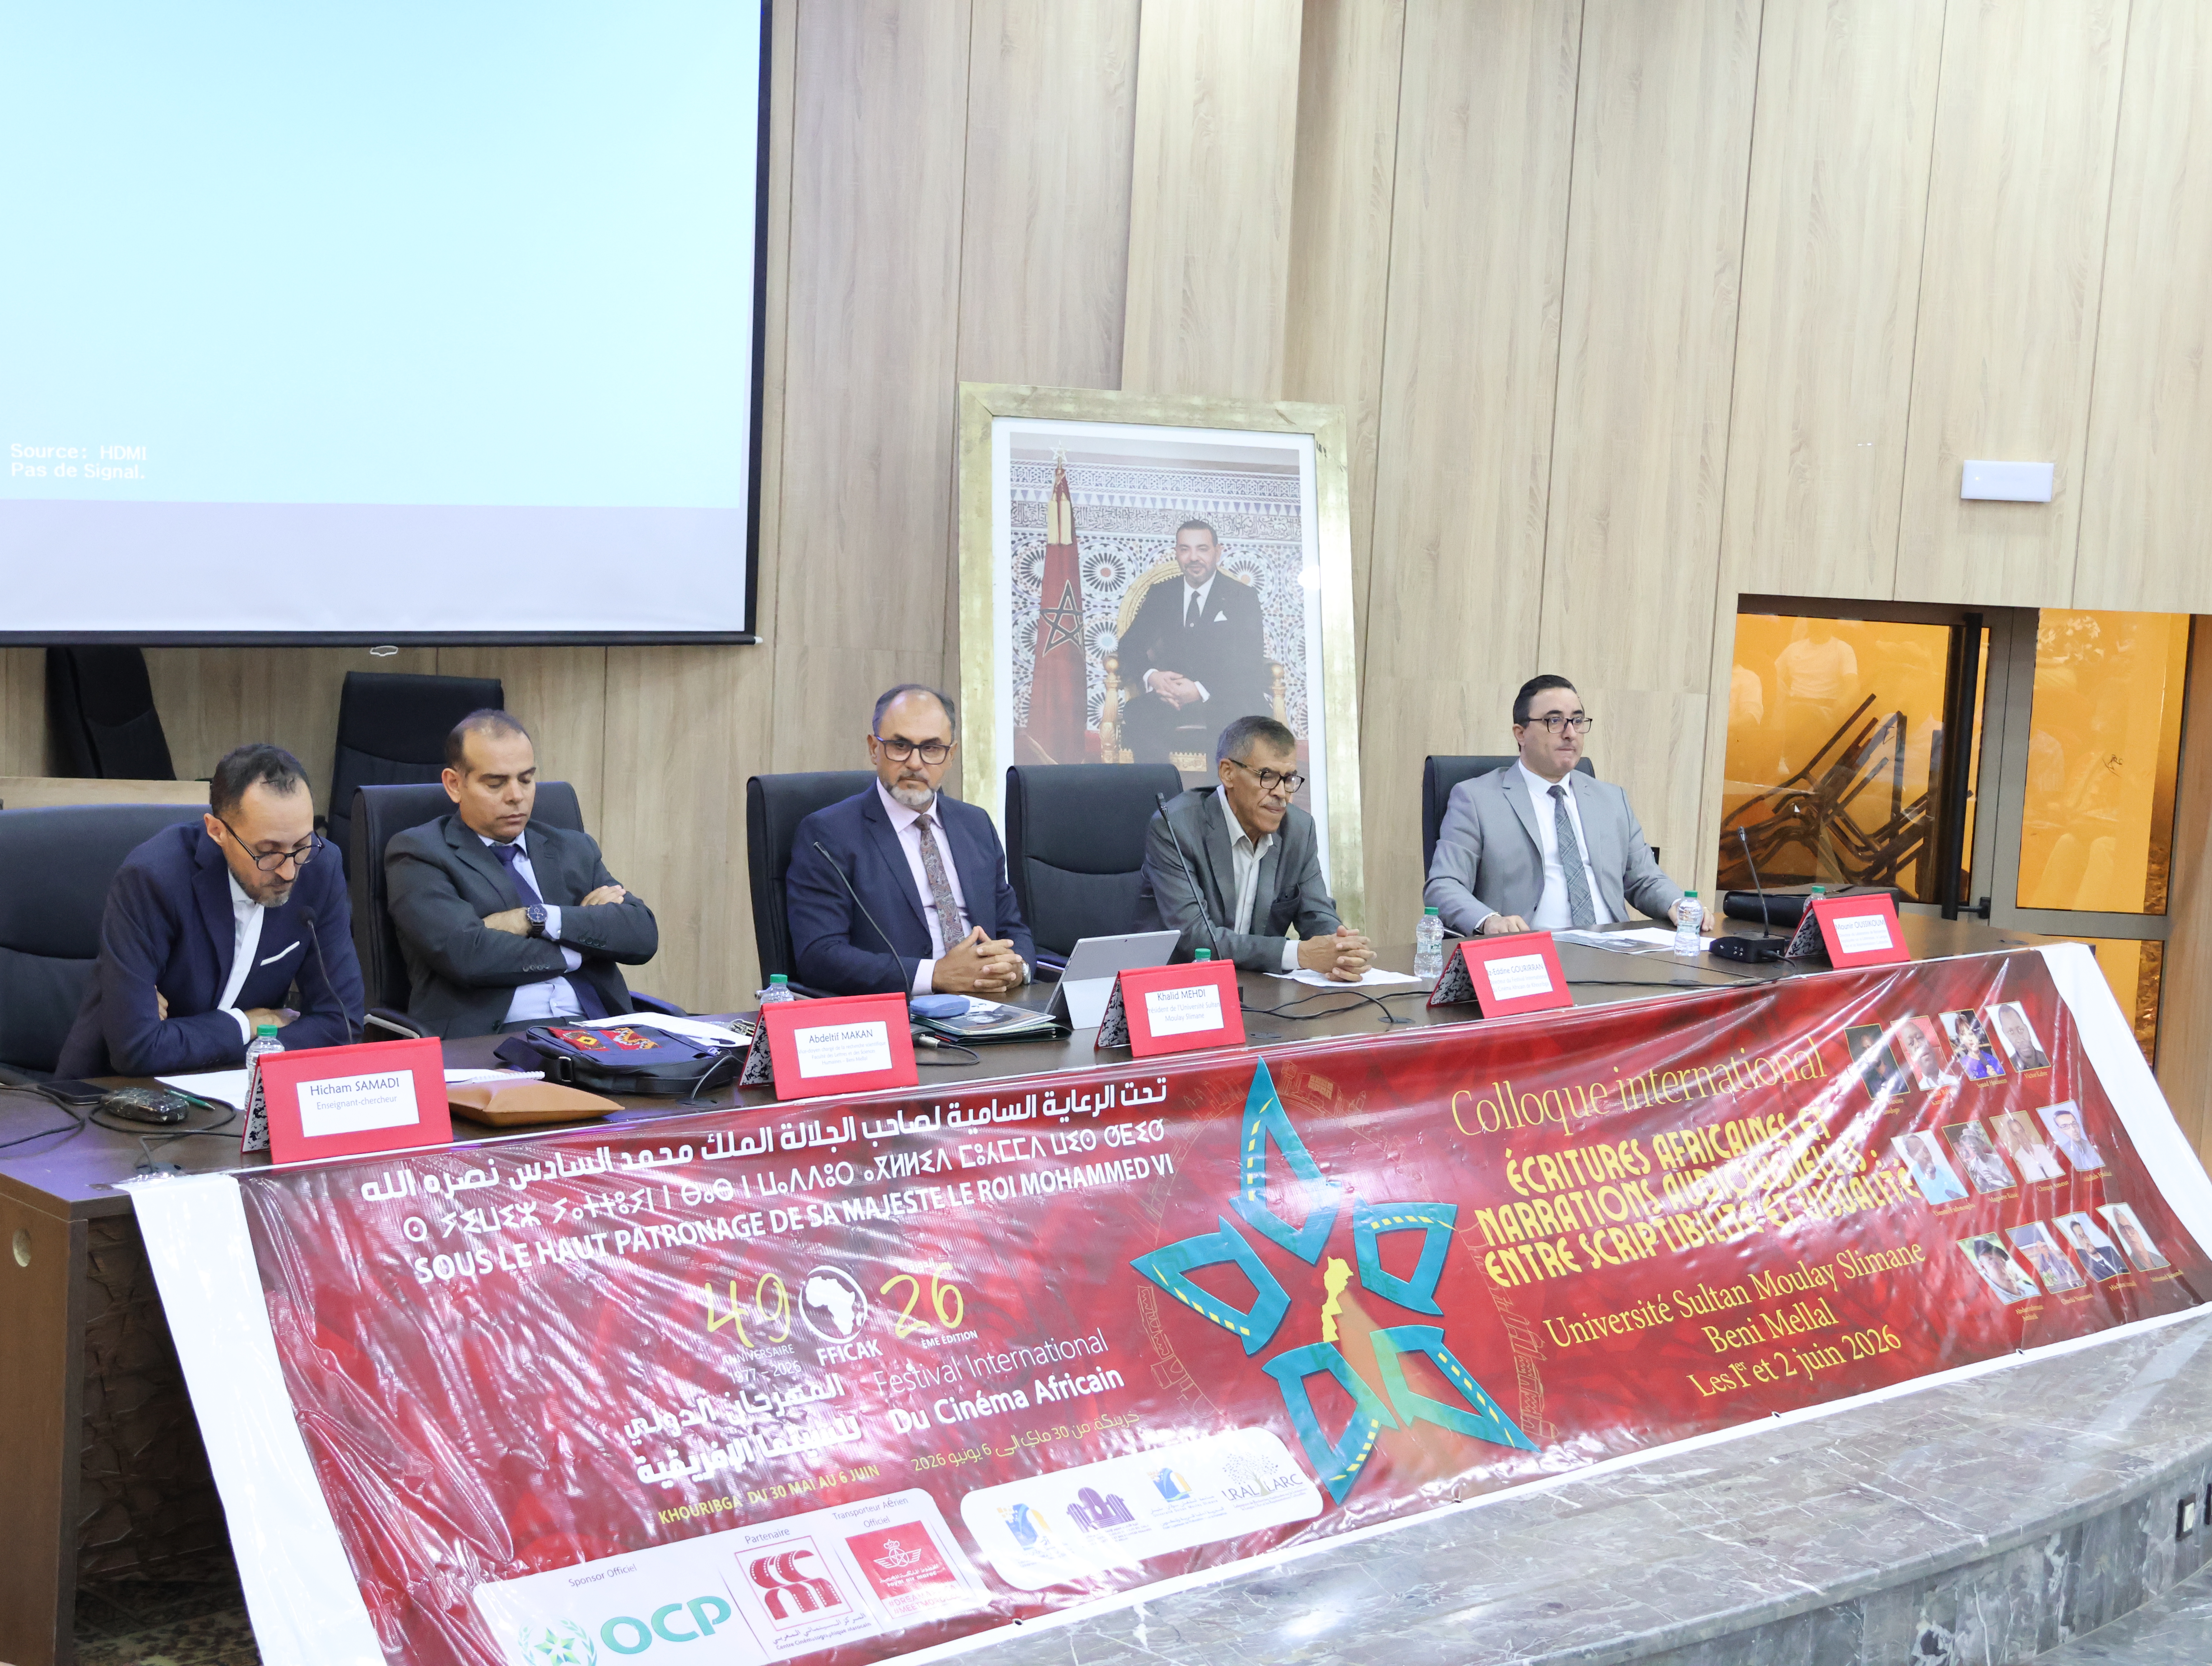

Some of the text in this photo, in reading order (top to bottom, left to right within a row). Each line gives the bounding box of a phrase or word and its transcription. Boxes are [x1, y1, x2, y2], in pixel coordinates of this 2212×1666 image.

[100, 445, 147, 460] HDMI
[11, 462, 144, 480] Pas de Signal.
[1854, 919, 1885, 928] OUSSIKOUM
[1511, 963, 1543, 973] GOURIRRAN
[1157, 989, 1206, 1001] Khalid MEHDI
[809, 1029, 873, 1043] Abdeltif MAKAN
[310, 1078, 399, 1096] Hicham SAMADI
[1451, 1036, 1827, 1136] Colloque international
[317, 1095, 397, 1110] Enseignant-chercheur
[361, 1077, 1167, 1202] تحت الرعاية السامية لصاحب الجلالة الملك محمد السادس نصره الله
[1505, 1106, 1831, 1196] ÉCRITURES AFRICAINES ET
[414, 1153, 1174, 1284] SOUS LE HAUT PATRONAGE DE SA MAJESTE LE ROI MOHAMMED VI
[1474, 1178, 1662, 1247] NARRATIONS
[1485, 1236, 1582, 1288] ENTRE
[1762, 1192, 1795, 1228] ET
[880, 1262, 964, 1339] 26
[1542, 1241, 1926, 1348] Université Sultan Moulay Slimane
[705, 1272, 791, 1348] 49
[1701, 1297, 1840, 1353] Beni Mellal
[921, 1330, 978, 1349] ÈME ÉDITION
[722, 1344, 795, 1365] ANNIVERSAIRE
[816, 1339, 883, 1367] FFICAK
[873, 1327, 1110, 1397] Festival International
[1753, 1358, 1780, 1382] et
[1774, 1352, 1798, 1377] 2
[1792, 1342, 1847, 1381] juin
[1841, 1324, 1902, 1360] 2026
[728, 1360, 802, 1384] 1977 2026
[624, 1373, 845, 1446] المهرجان الدولي
[888, 1365, 1125, 1434] Du Cinéma Africain
[756, 1415, 861, 1458] للسينما
[1021, 1429, 1052, 1448] ماي
[1054, 1426, 1070, 1441] 30
[1070, 1423, 1091, 1439] من
[948, 1447, 984, 1467] يونيو
[982, 1443, 992, 1456] 6
[911, 1454, 947, 1471] 2026
[658, 1464, 880, 1525] KHOURIBGA DU 30 MAI AU 6 JUIN
[1222, 1484, 1260, 1501] LRAL
[1263, 1474, 1303, 1492] LARC
[832, 1496, 909, 1521] Transporteur Aérien
[864, 1516, 891, 1528] Officiel
[745, 1527, 790, 1545] Partenaire
[568, 1563, 637, 1587] Sponsor Officiel
[917, 1570, 938, 1579] maroc
[600, 1596, 731, 1655] OCP
[847, 1622, 872, 1632] Marocain
